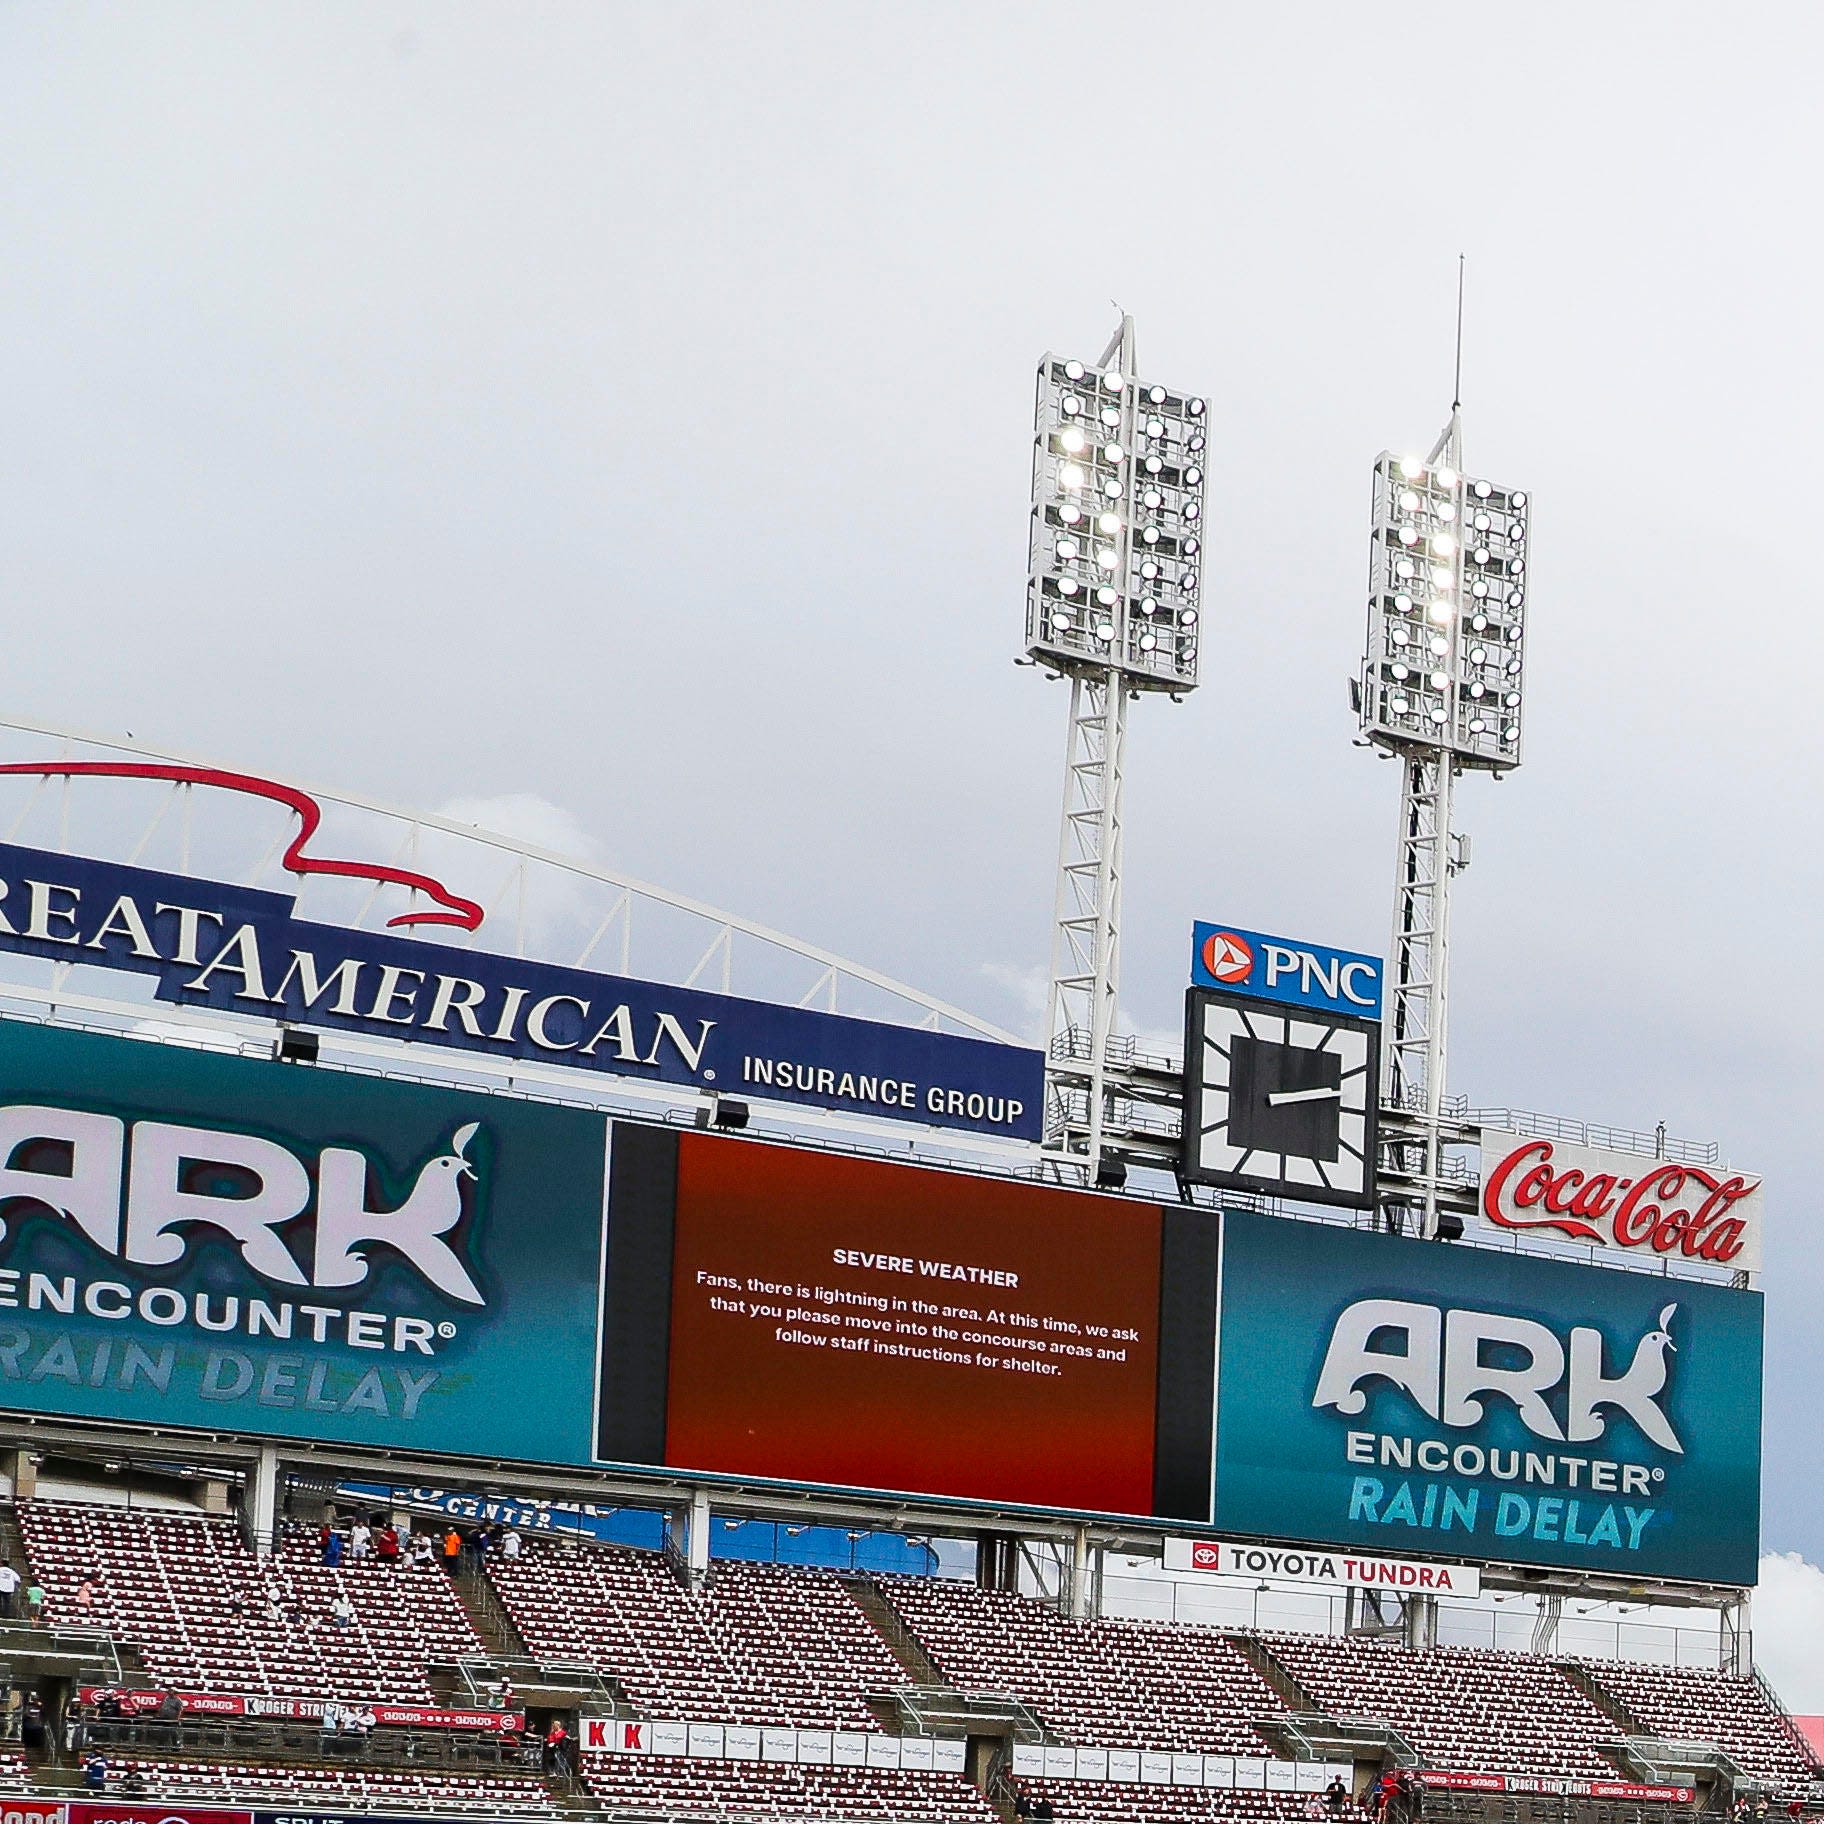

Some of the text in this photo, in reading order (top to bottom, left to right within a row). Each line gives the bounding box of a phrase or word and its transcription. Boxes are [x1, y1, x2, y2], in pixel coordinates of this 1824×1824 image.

[1261, 944, 1376, 1005] PNC
[743, 1056, 1024, 1124] INSURANCE GROUP
[1485, 1140, 1761, 1260] Coca-Cola
[833, 1249, 1019, 1288] SEVERE WEATHER
[697, 1271, 1139, 1342] Fans, there is lightning in the area. At this time, we ask
[710, 1297, 1126, 1362] that you please move into the concourse areas and
[776, 1328, 1062, 1376] follow staff instructions for shelter.
[1312, 1299, 1685, 1455] ARK
[201, 1350, 441, 1420] DELAY
[1346, 1431, 1652, 1496] ENCOUNTER
[447, 1502, 551, 1529] CENTER
[1349, 1476, 1655, 1550] RAIN DELAY
[1231, 1548, 1452, 1589] TOYOTA TUNDRA
